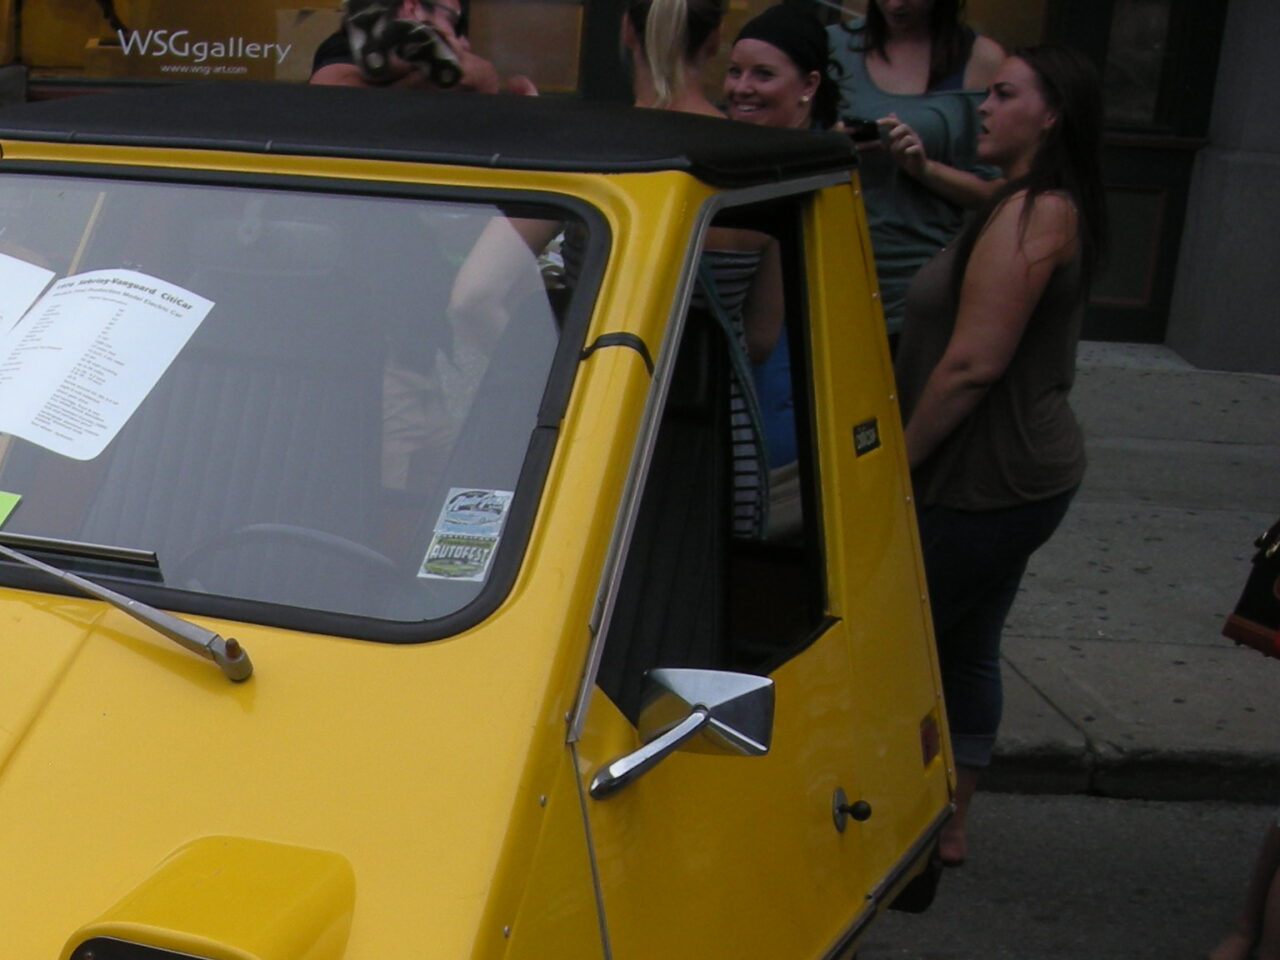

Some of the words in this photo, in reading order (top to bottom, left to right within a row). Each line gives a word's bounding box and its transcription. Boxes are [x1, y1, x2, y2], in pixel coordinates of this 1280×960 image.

[117, 28, 291, 64] WSGgallery
[161, 291, 193, 310] CitiCar
[430, 544, 490, 562] AUTOFEST
